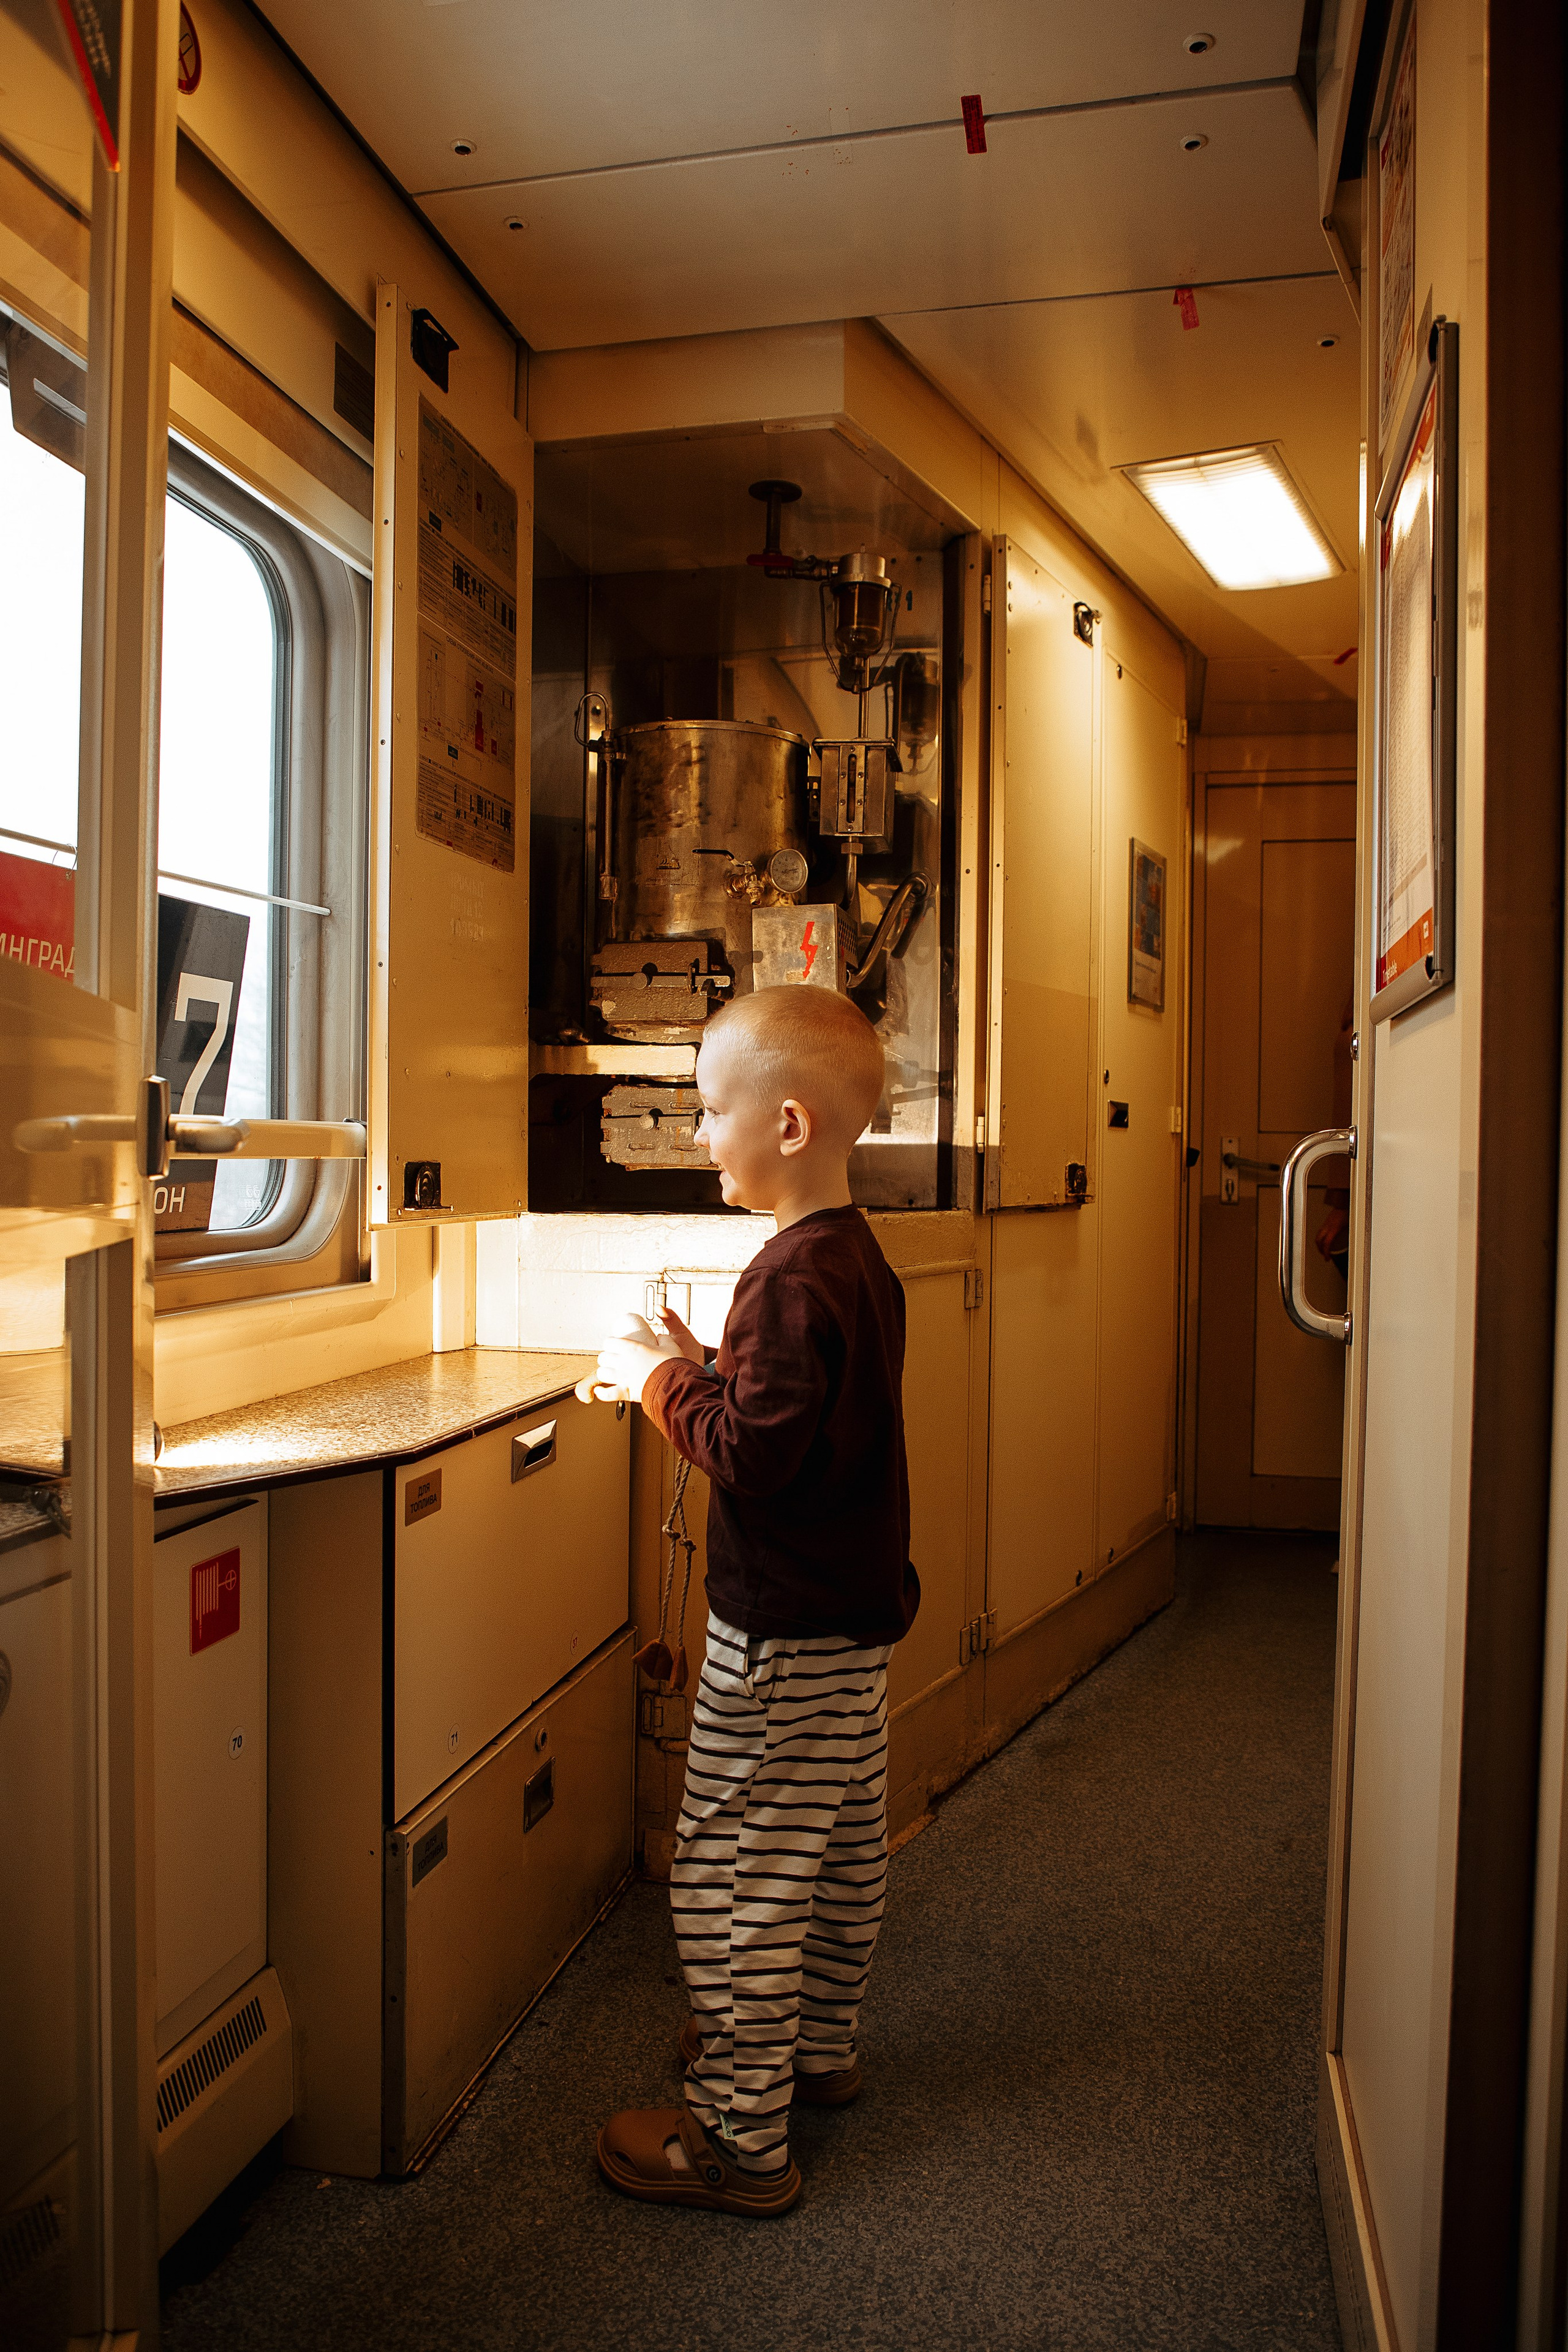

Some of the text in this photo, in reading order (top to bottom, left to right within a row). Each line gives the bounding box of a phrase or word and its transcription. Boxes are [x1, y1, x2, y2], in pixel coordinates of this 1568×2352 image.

[174, 972, 234, 1115] 7
[418, 1482, 431, 1498] ДЛЯ
[410, 1493, 437, 1513] ТОПЛИВА
[232, 1735, 243, 1751] 70
[451, 1731, 458, 1746] 71
[424, 1834, 437, 1854] ДЛЯ
[418, 1842, 444, 1872] ТОПЛИВА
